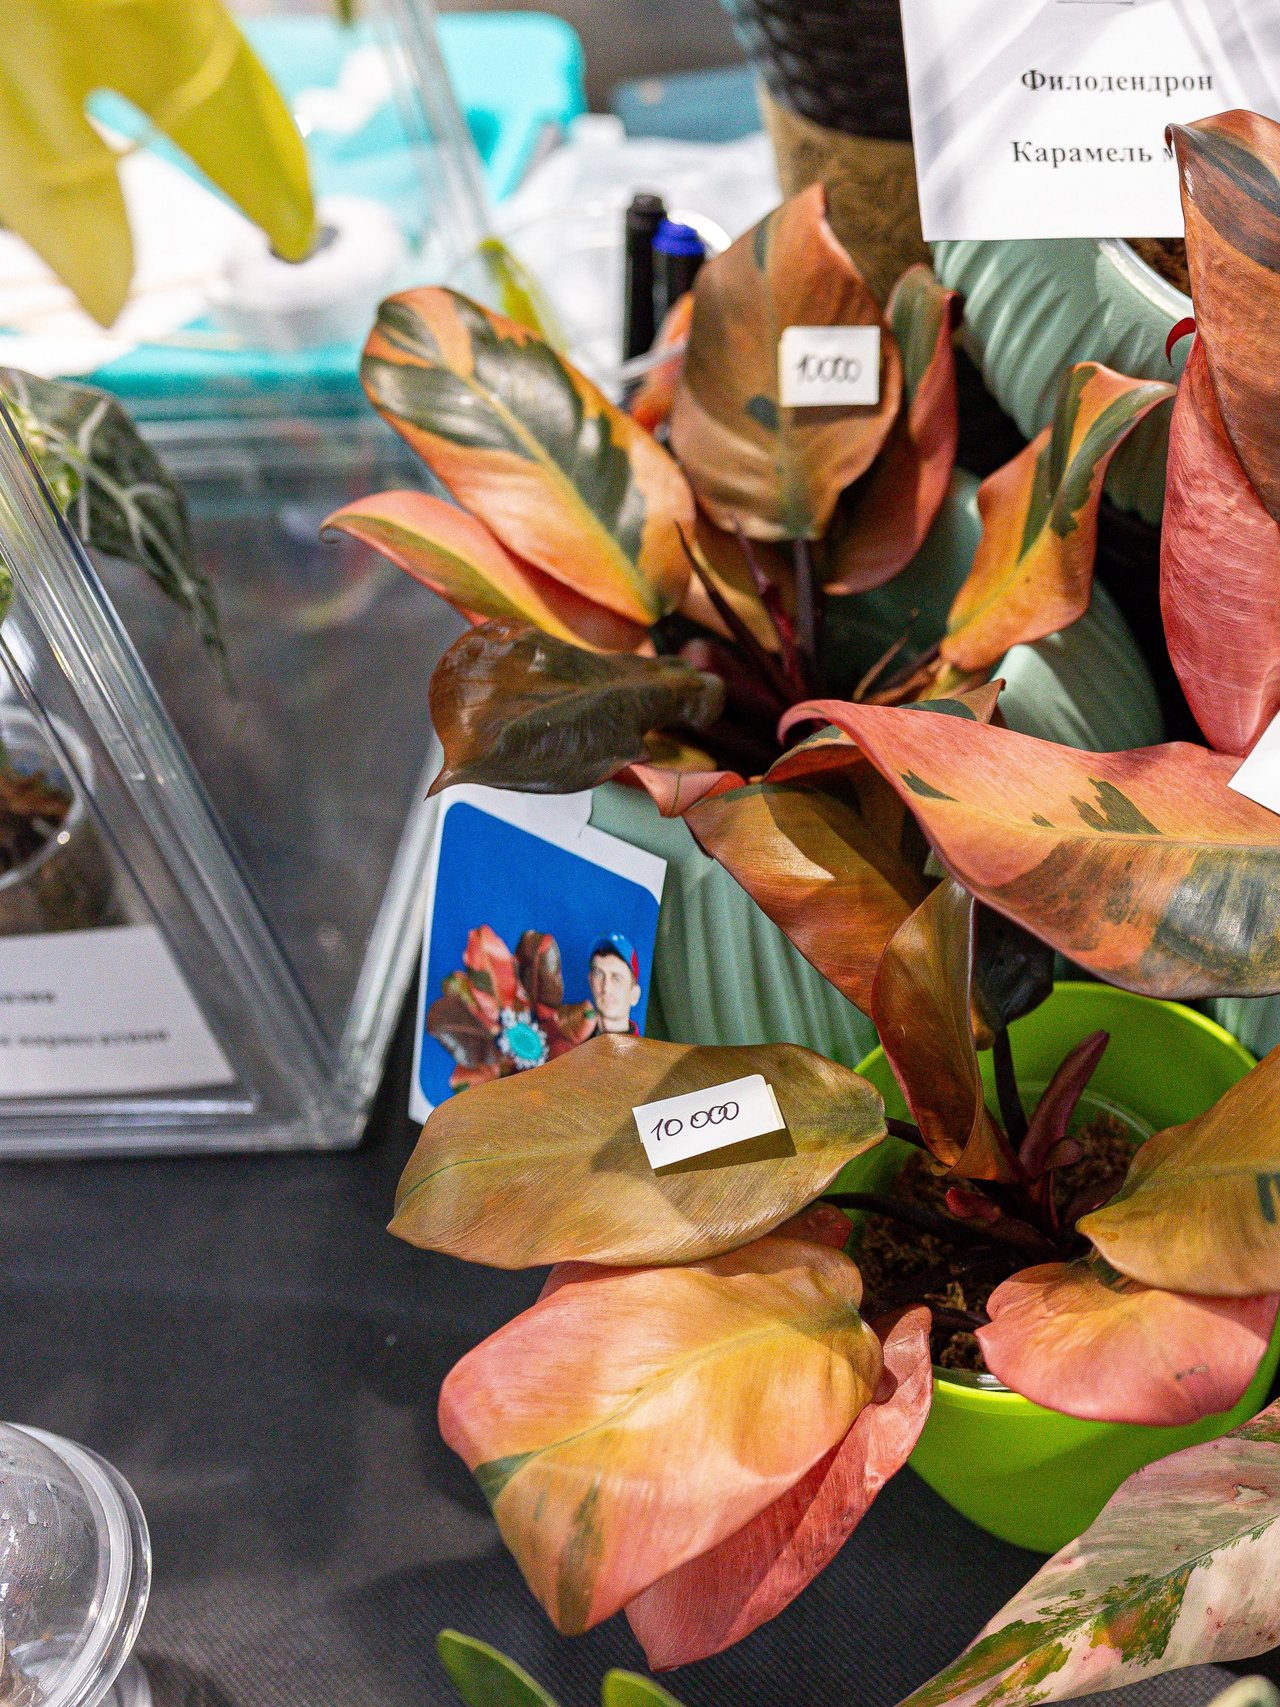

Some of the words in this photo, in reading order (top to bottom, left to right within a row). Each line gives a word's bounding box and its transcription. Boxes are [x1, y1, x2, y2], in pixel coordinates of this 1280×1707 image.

[1020, 69, 1213, 97] Филодендрон
[1010, 140, 1153, 169] Карамель
[796, 353, 864, 385] 10000
[650, 1118, 684, 1142] 10
[690, 1101, 740, 1129] 000
